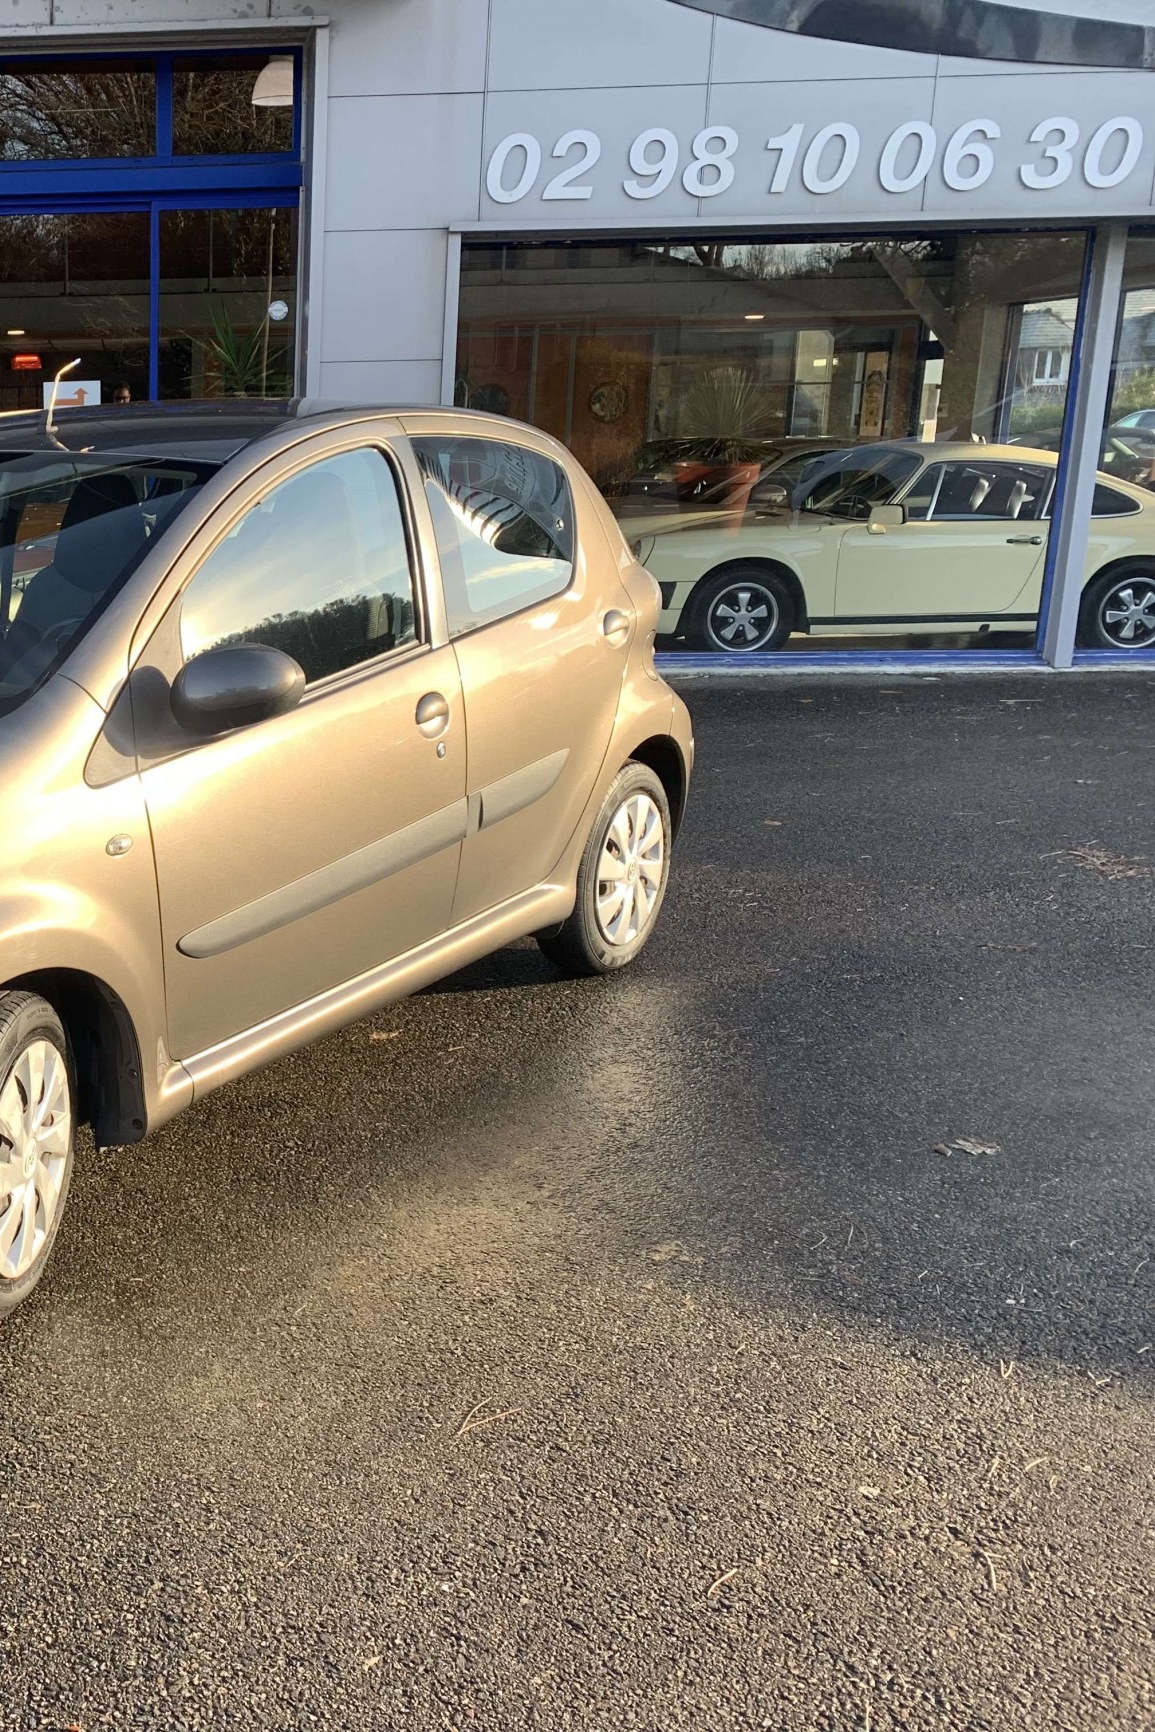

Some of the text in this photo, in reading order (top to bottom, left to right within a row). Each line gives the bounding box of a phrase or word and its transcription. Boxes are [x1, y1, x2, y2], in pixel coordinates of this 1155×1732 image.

[486, 116, 1144, 204] 02 98 10 06 30
